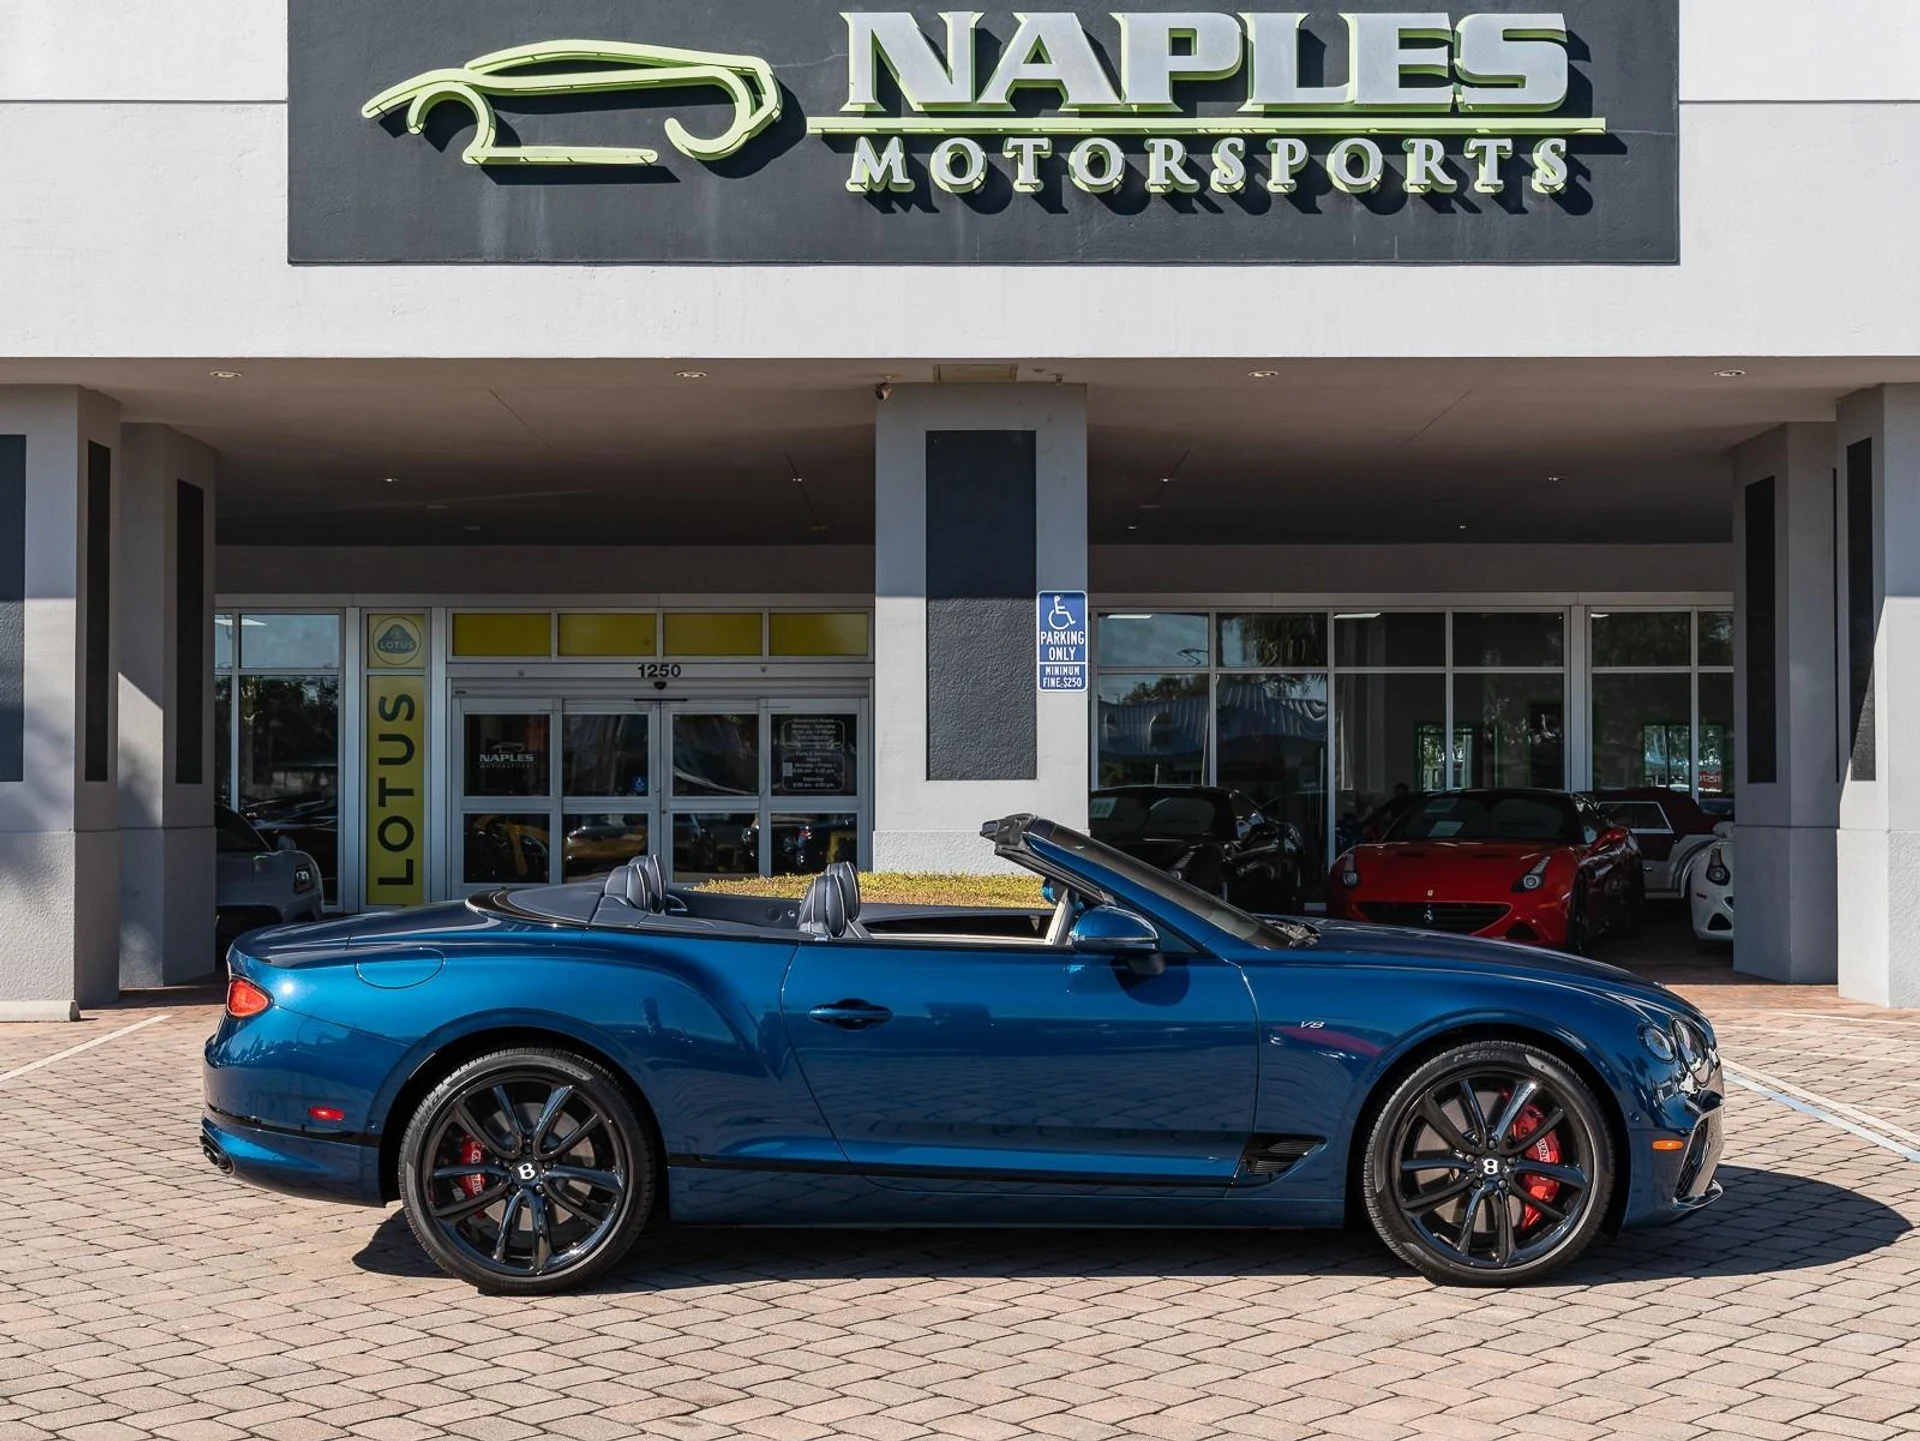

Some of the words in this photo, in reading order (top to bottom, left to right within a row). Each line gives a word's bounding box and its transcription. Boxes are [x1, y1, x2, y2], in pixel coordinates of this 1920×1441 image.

[839, 11, 1568, 112] NAPLES
[846, 137, 1568, 193] MOTORSPORTS
[1040, 631, 1085, 645] PARKING
[380, 641, 416, 650] LOTUS
[1048, 646, 1076, 661] ONLY
[637, 664, 682, 678] 1250
[1045, 665, 1080, 676] MINIMUM
[1042, 676, 1061, 688] FINE
[1063, 676, 1083, 689] $250
[480, 753, 535, 762] NAPLES
[378, 694, 415, 886] LOTUS
[1300, 1021, 1325, 1029] V8
[519, 1163, 536, 1180] B
